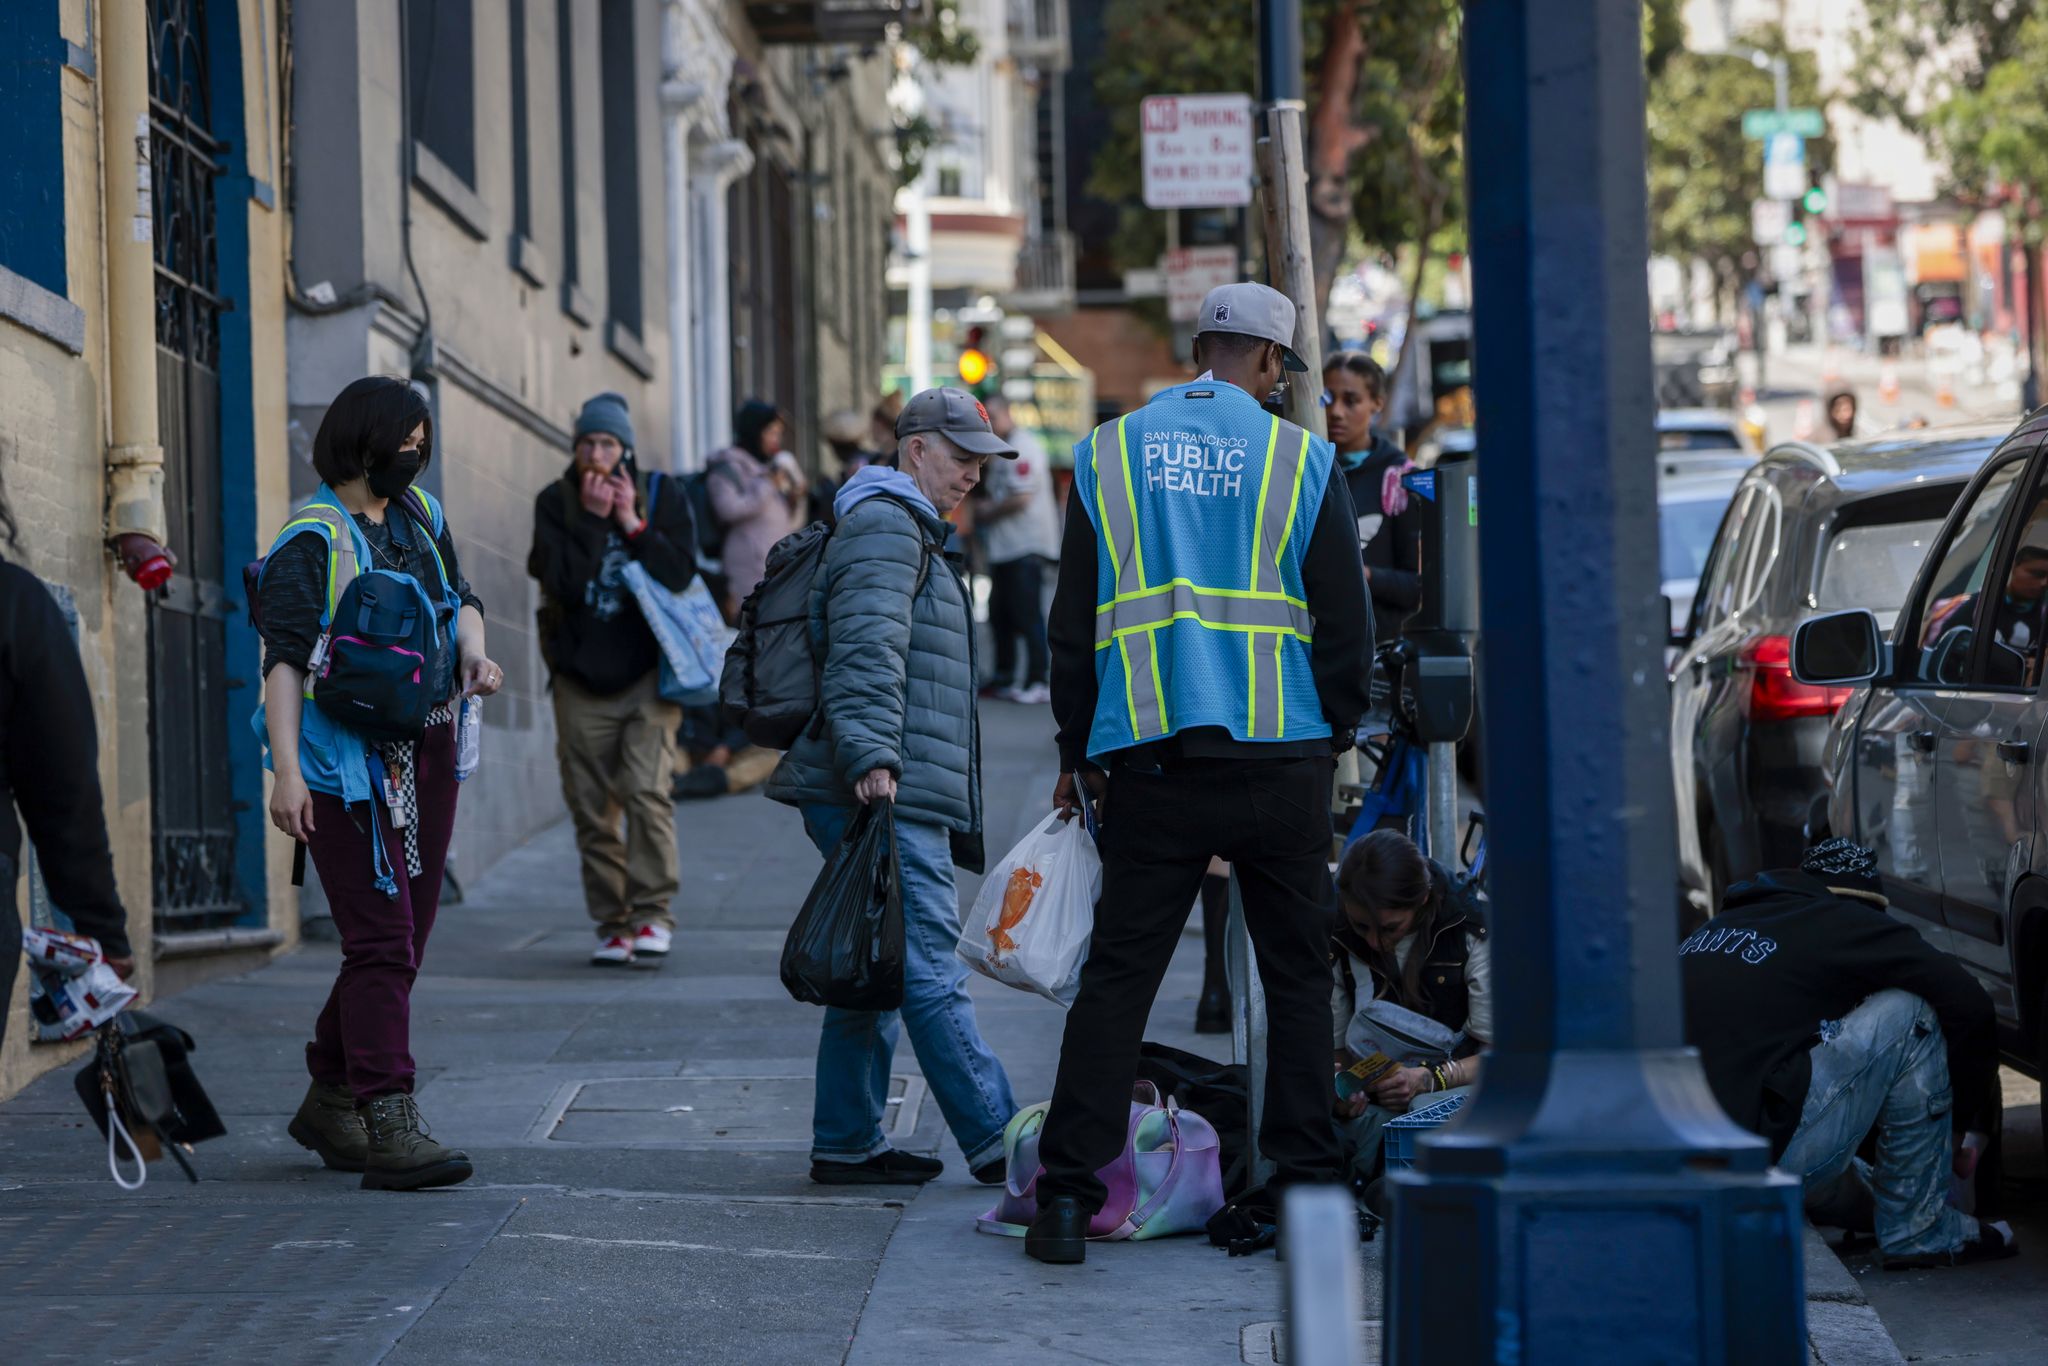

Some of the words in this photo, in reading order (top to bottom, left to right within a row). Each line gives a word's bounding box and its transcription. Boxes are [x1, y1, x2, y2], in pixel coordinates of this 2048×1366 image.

[1144, 431, 1170, 443] SAN
[1173, 431, 1248, 448] FRANCISCO
[1144, 442, 1246, 472] PUBLIC
[1146, 466, 1242, 497] HEALTH
[1679, 928, 1777, 964] ANTS
